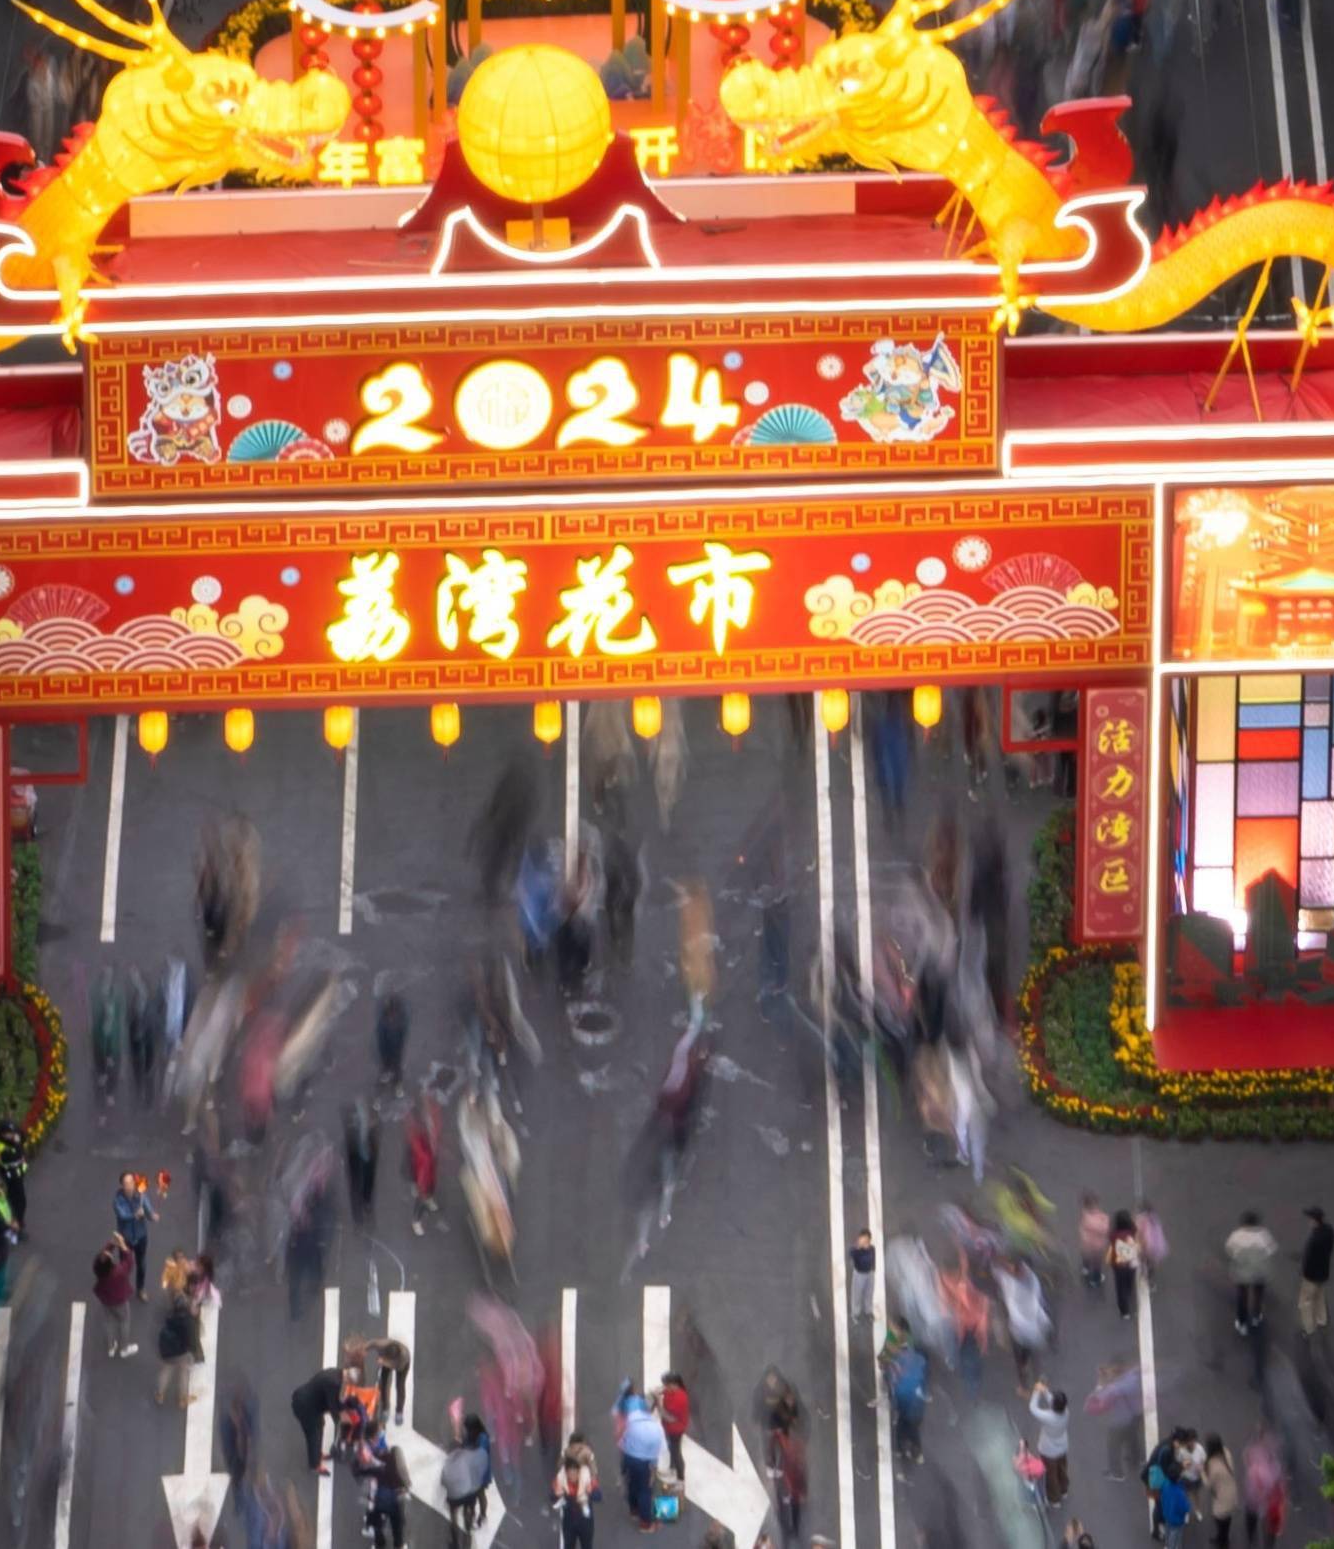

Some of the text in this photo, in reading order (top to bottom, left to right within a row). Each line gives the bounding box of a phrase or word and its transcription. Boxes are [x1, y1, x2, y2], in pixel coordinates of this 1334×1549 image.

[351, 351, 741, 457] 2024
[328, 542, 773, 662] 荔湾花市
[1096, 718, 1135, 894] 活力湾区
